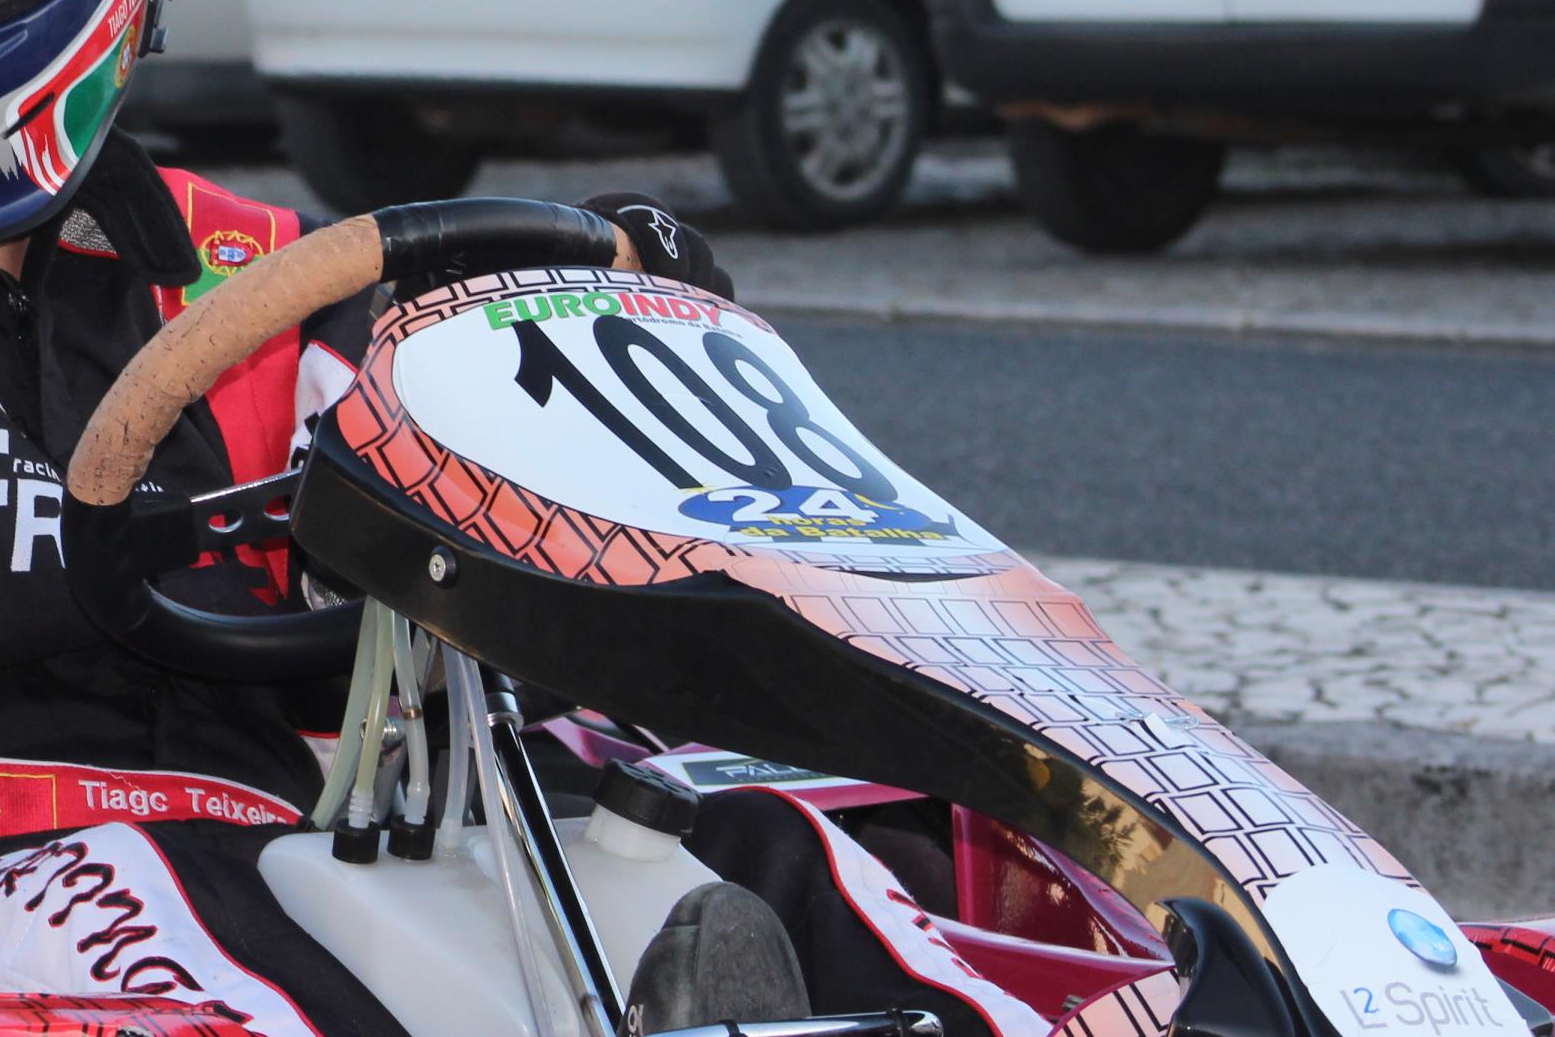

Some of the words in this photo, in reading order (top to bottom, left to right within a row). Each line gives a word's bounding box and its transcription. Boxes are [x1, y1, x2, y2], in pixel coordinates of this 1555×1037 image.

[483, 291, 722, 331] EUROINDY
[513, 314, 898, 502] 108
[707, 488, 878, 523] 24
[739, 526, 789, 537] da
[798, 526, 948, 541] Batalha
[1385, 981, 1503, 1036] Spirit
